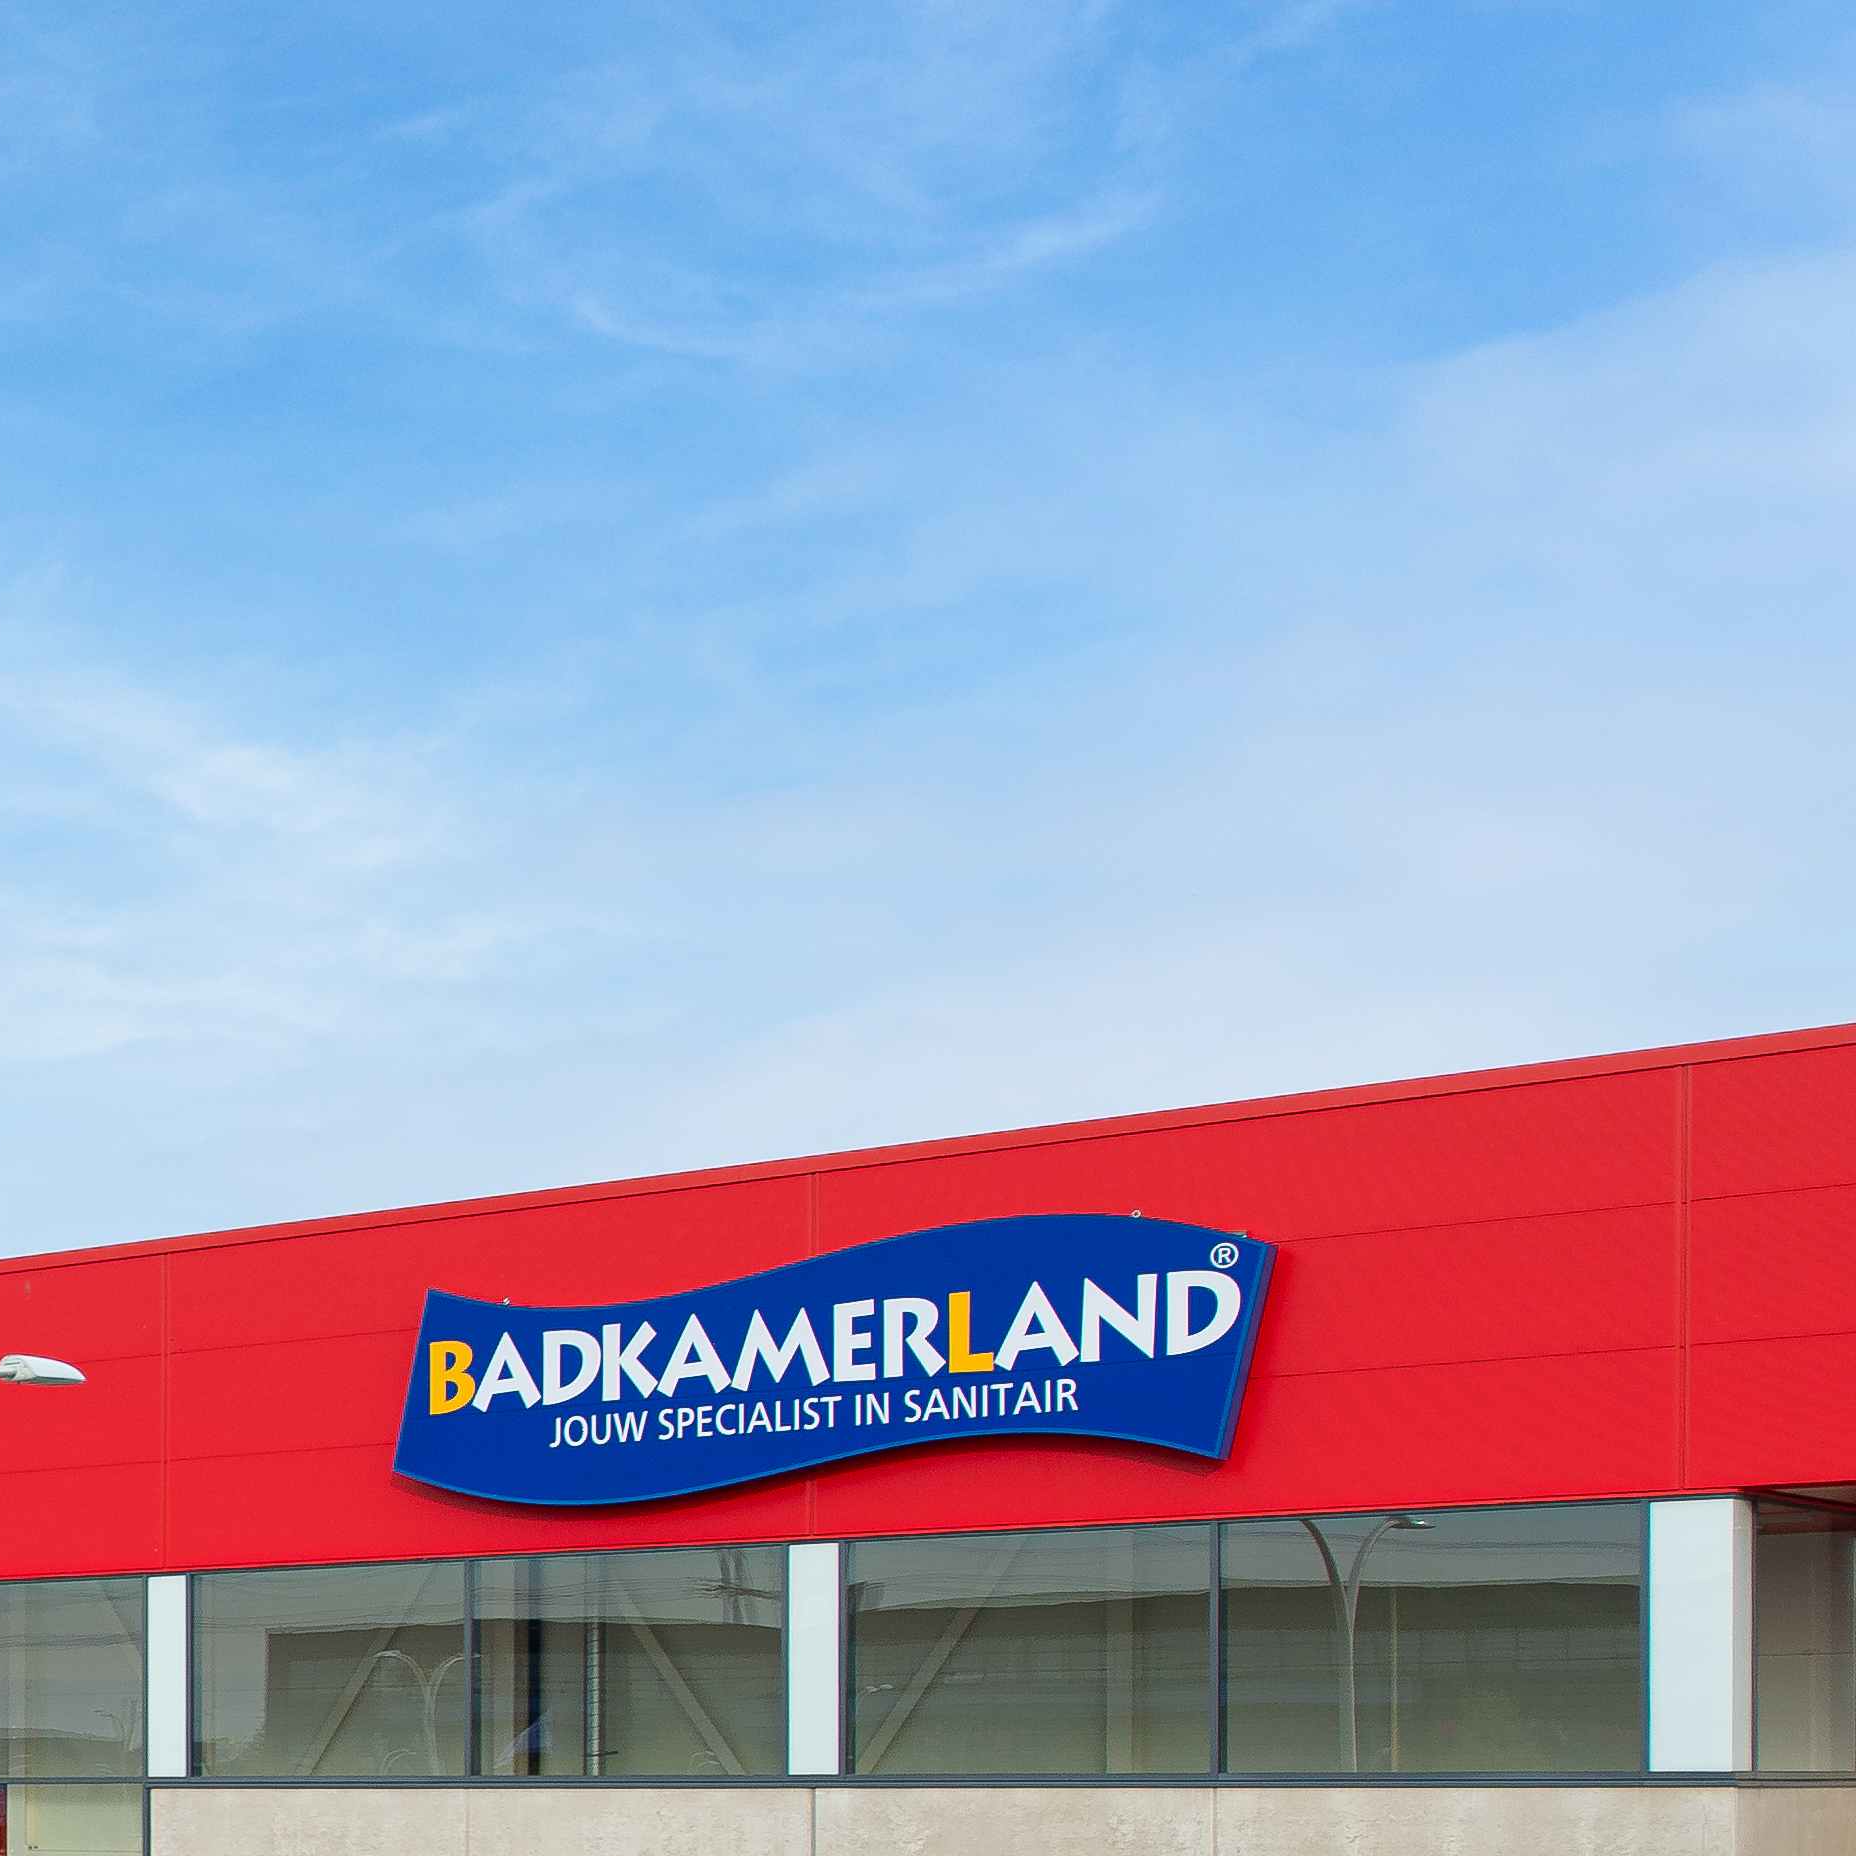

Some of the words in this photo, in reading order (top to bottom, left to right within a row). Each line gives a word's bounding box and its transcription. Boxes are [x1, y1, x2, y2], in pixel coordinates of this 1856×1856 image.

[429, 1269, 1242, 1416] BADKAMERLAND
[549, 1409, 649, 1449] JOUW
[657, 1395, 842, 1442] SPECIALIST
[853, 1391, 890, 1427] IN
[902, 1377, 1080, 1424] SANITAIR
